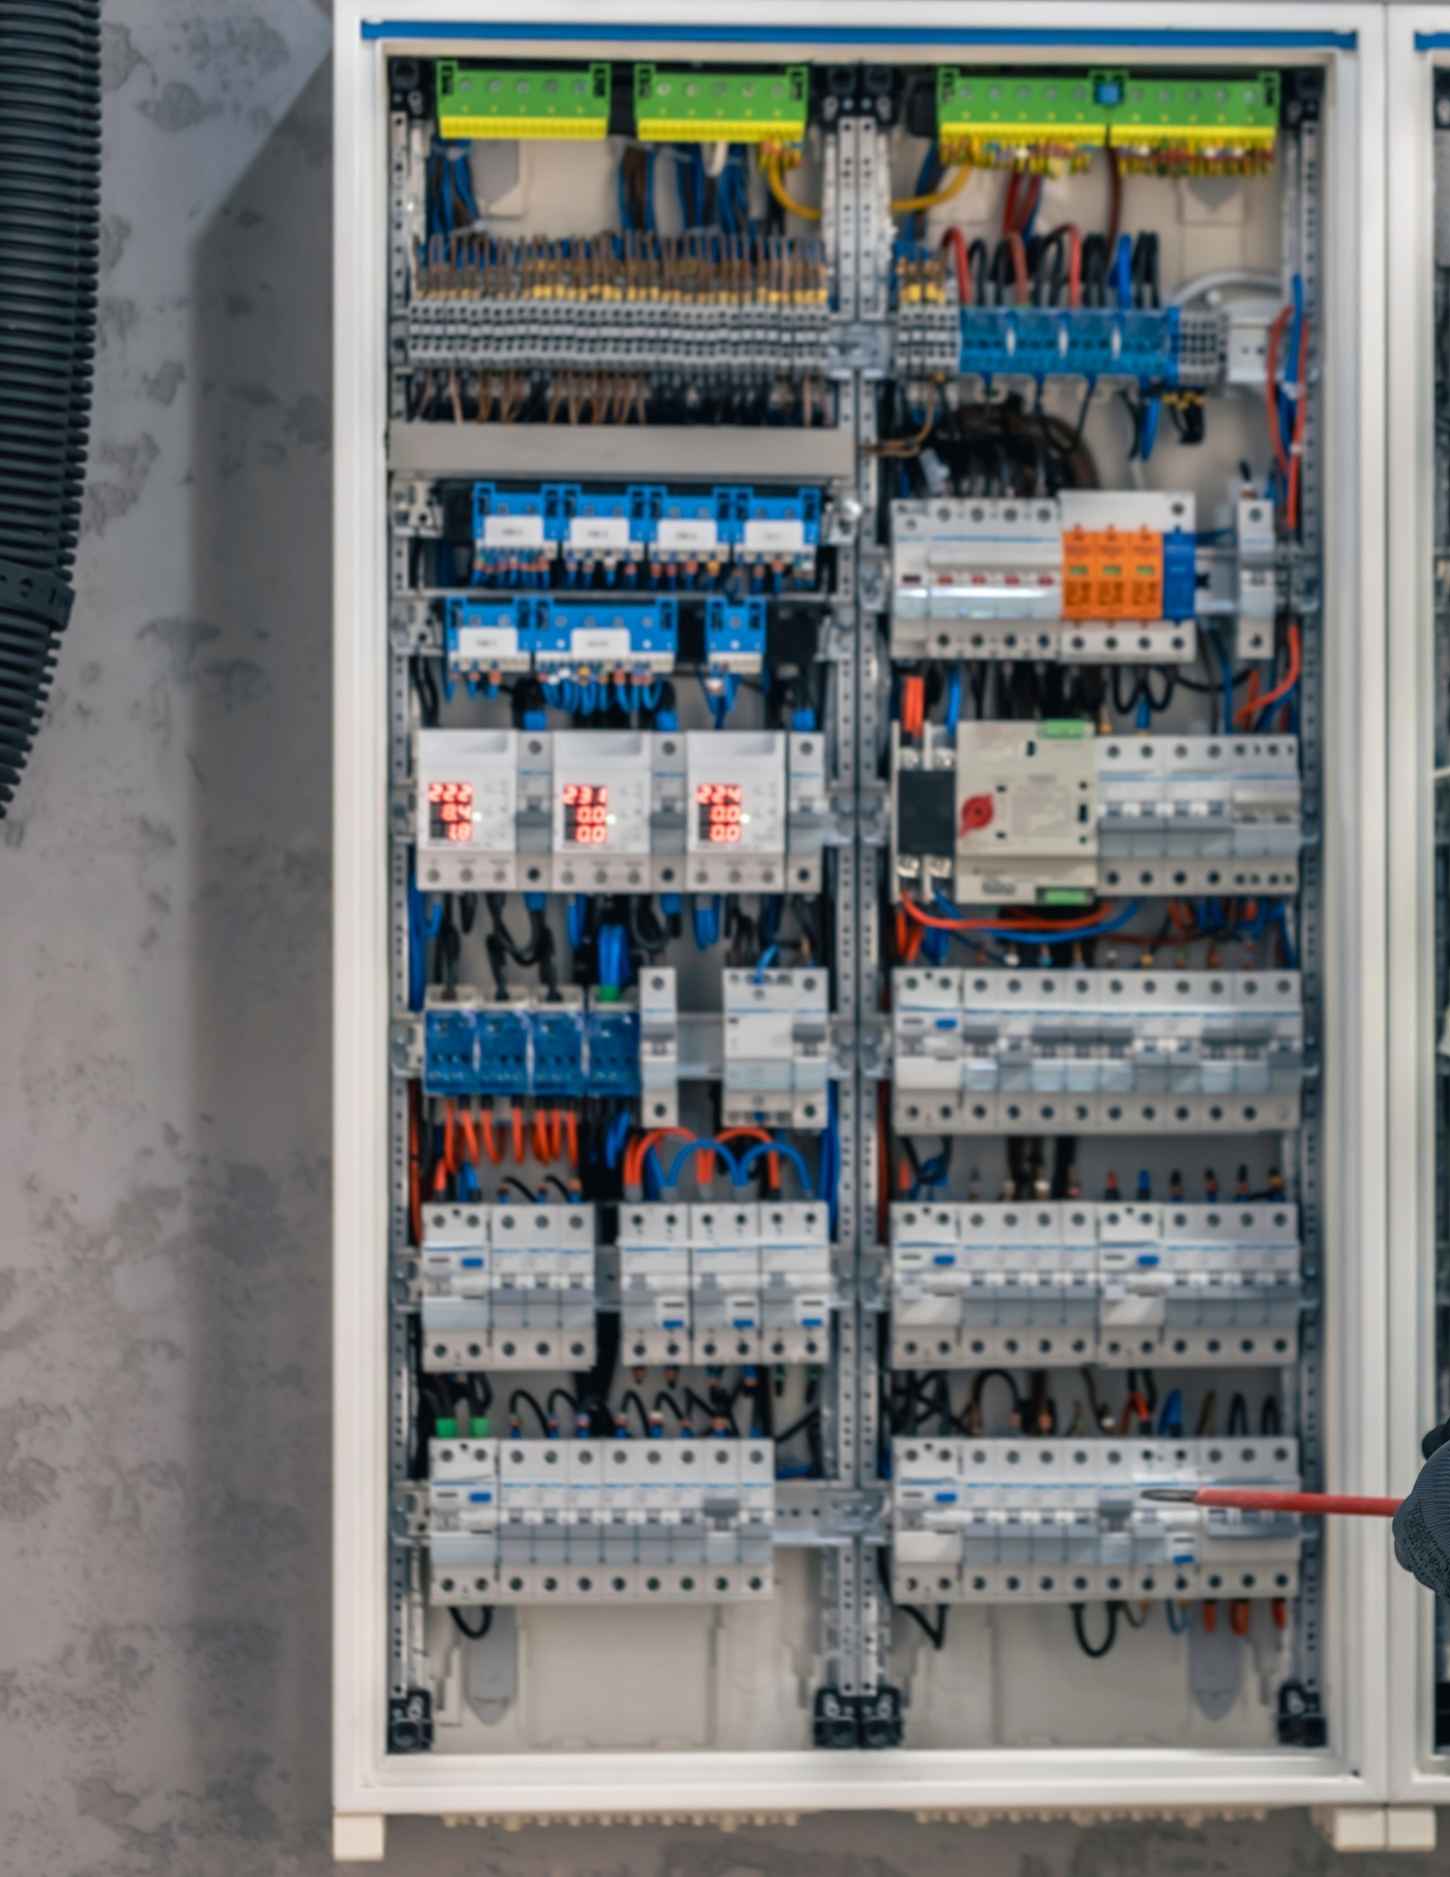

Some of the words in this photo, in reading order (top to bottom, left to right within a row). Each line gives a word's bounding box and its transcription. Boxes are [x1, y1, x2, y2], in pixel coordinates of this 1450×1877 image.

[429, 783, 472, 802] 222
[562, 785, 607, 803] 231
[695, 784, 741, 803] 224
